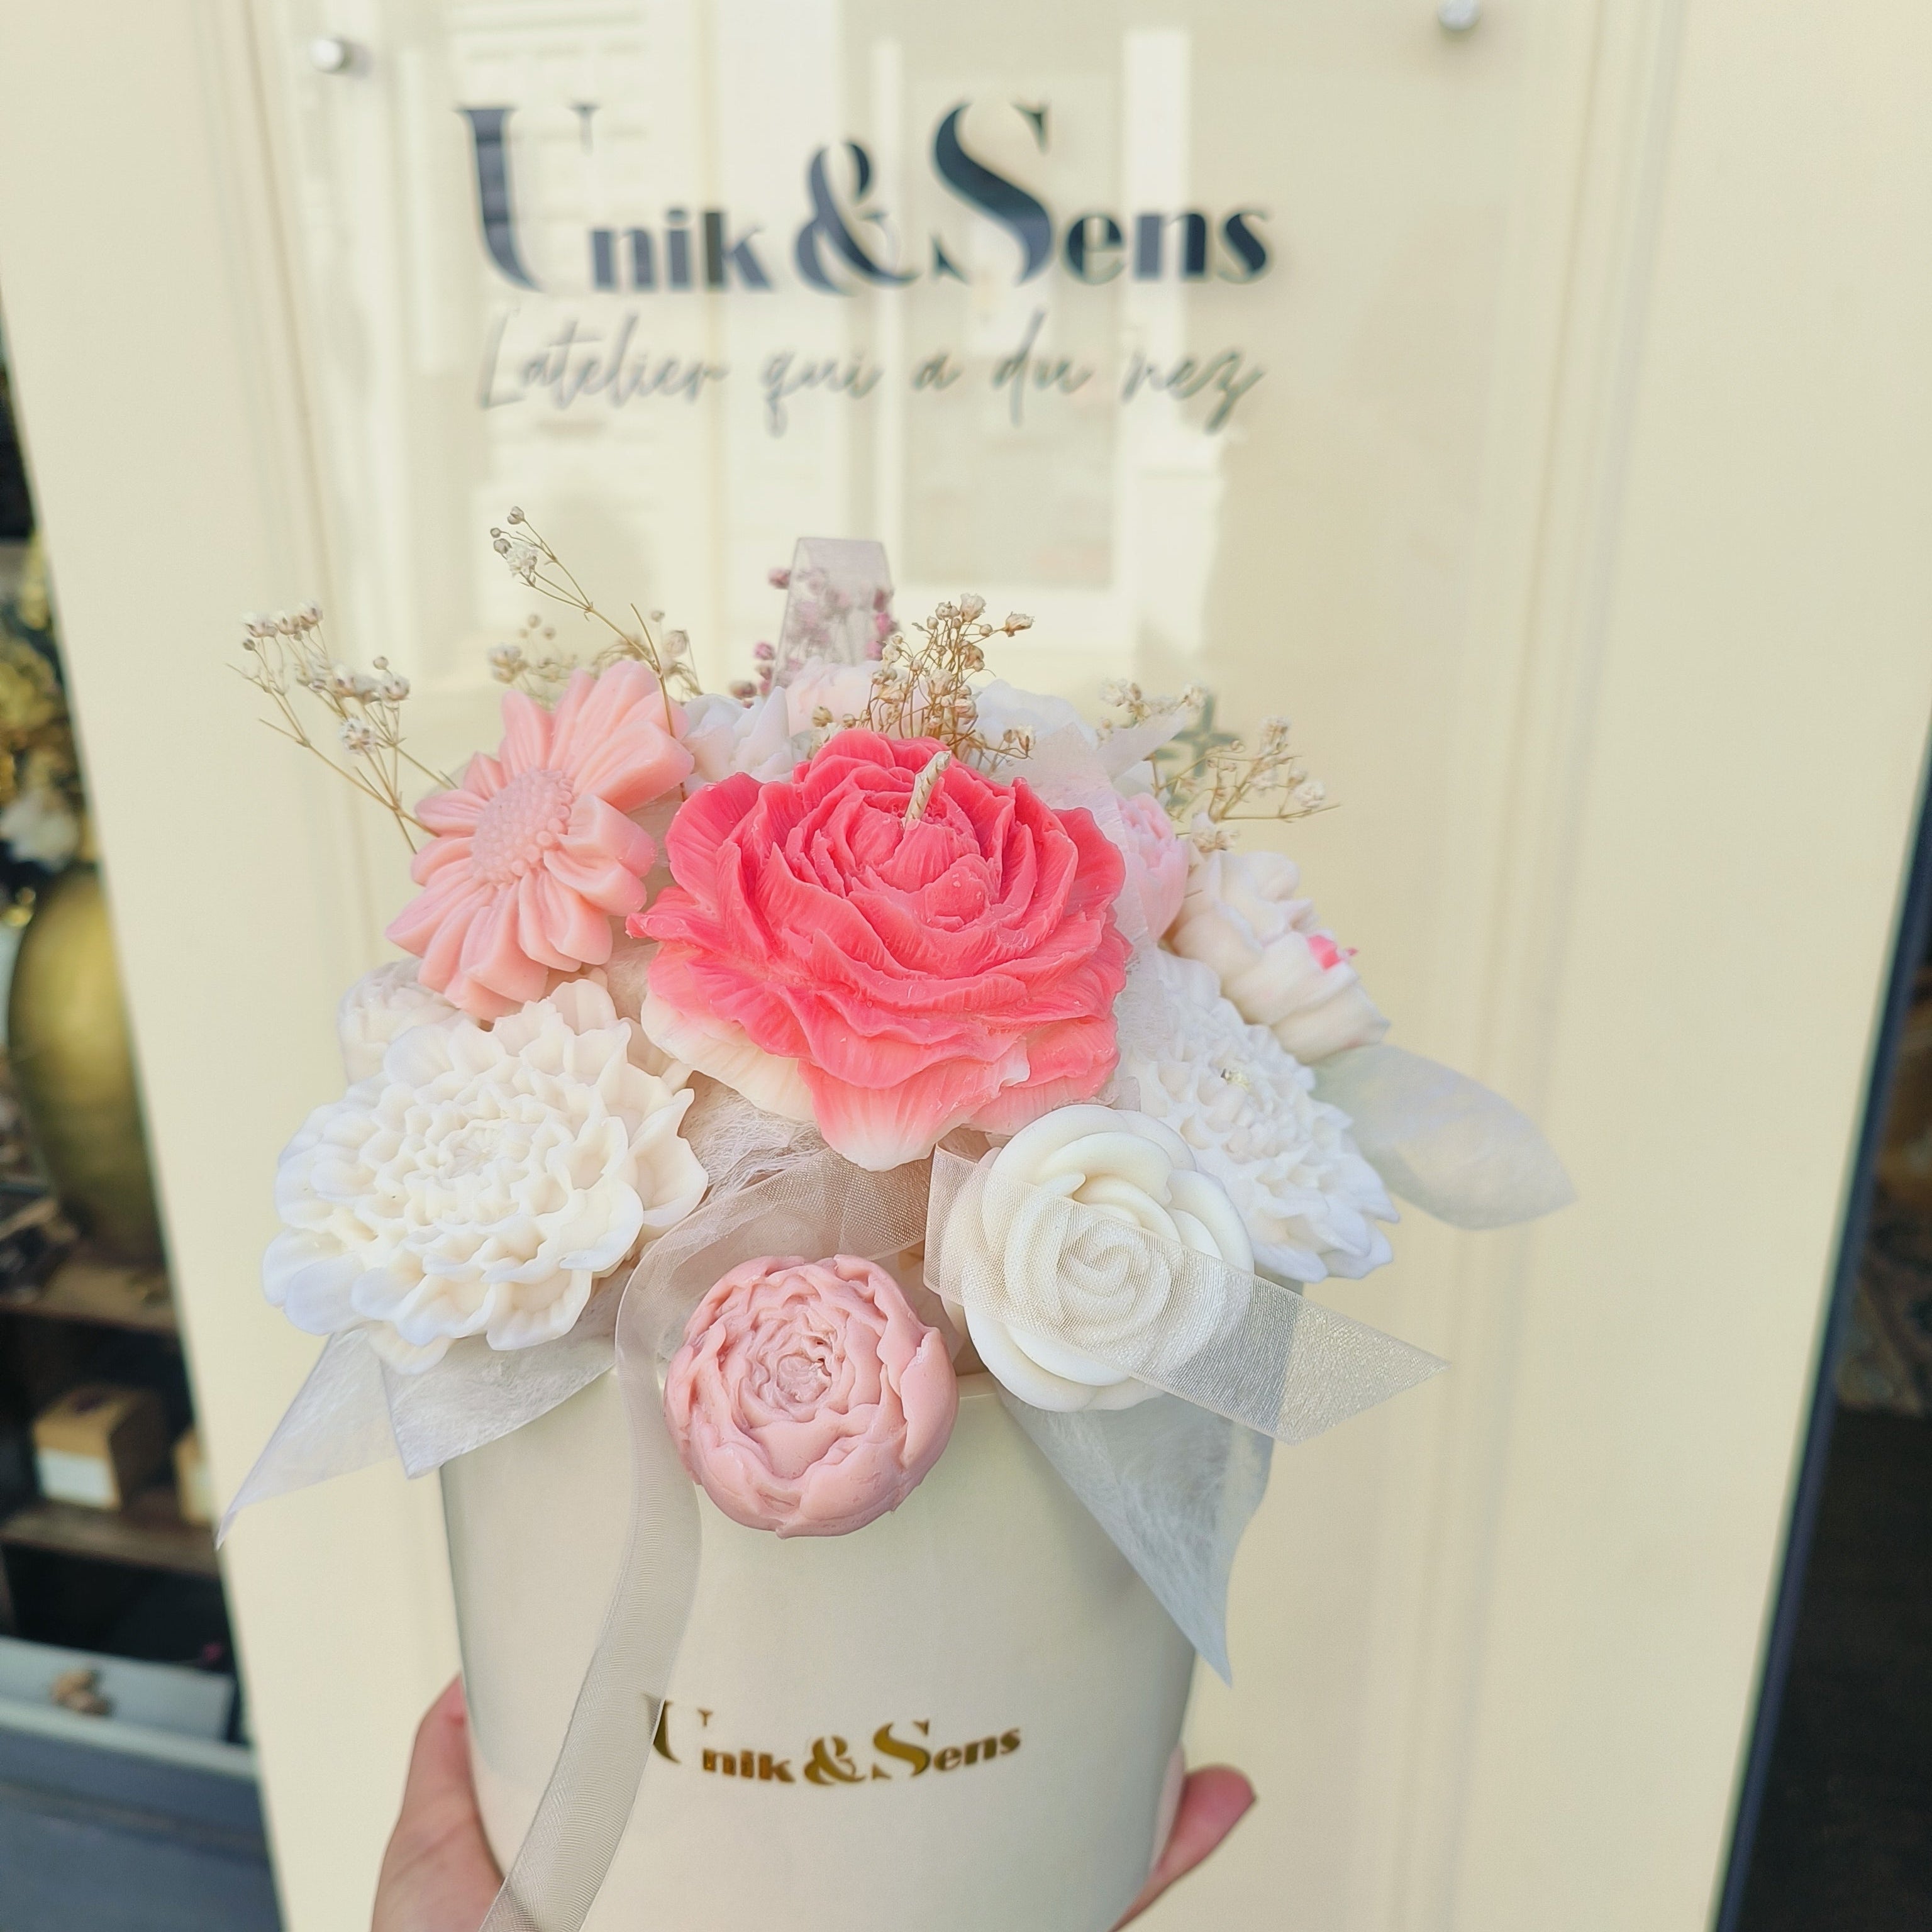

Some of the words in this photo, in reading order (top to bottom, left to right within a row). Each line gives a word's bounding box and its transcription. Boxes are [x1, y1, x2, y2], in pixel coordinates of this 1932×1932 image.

[457, 103, 774, 293] Unik
[930, 102, 1273, 287] Sens
[757, 347, 886, 439] qui
[912, 348, 965, 392] a
[991, 309, 1094, 428] du
[643, 1692, 796, 1782] Unik
[872, 1719, 1021, 1780] Sens
